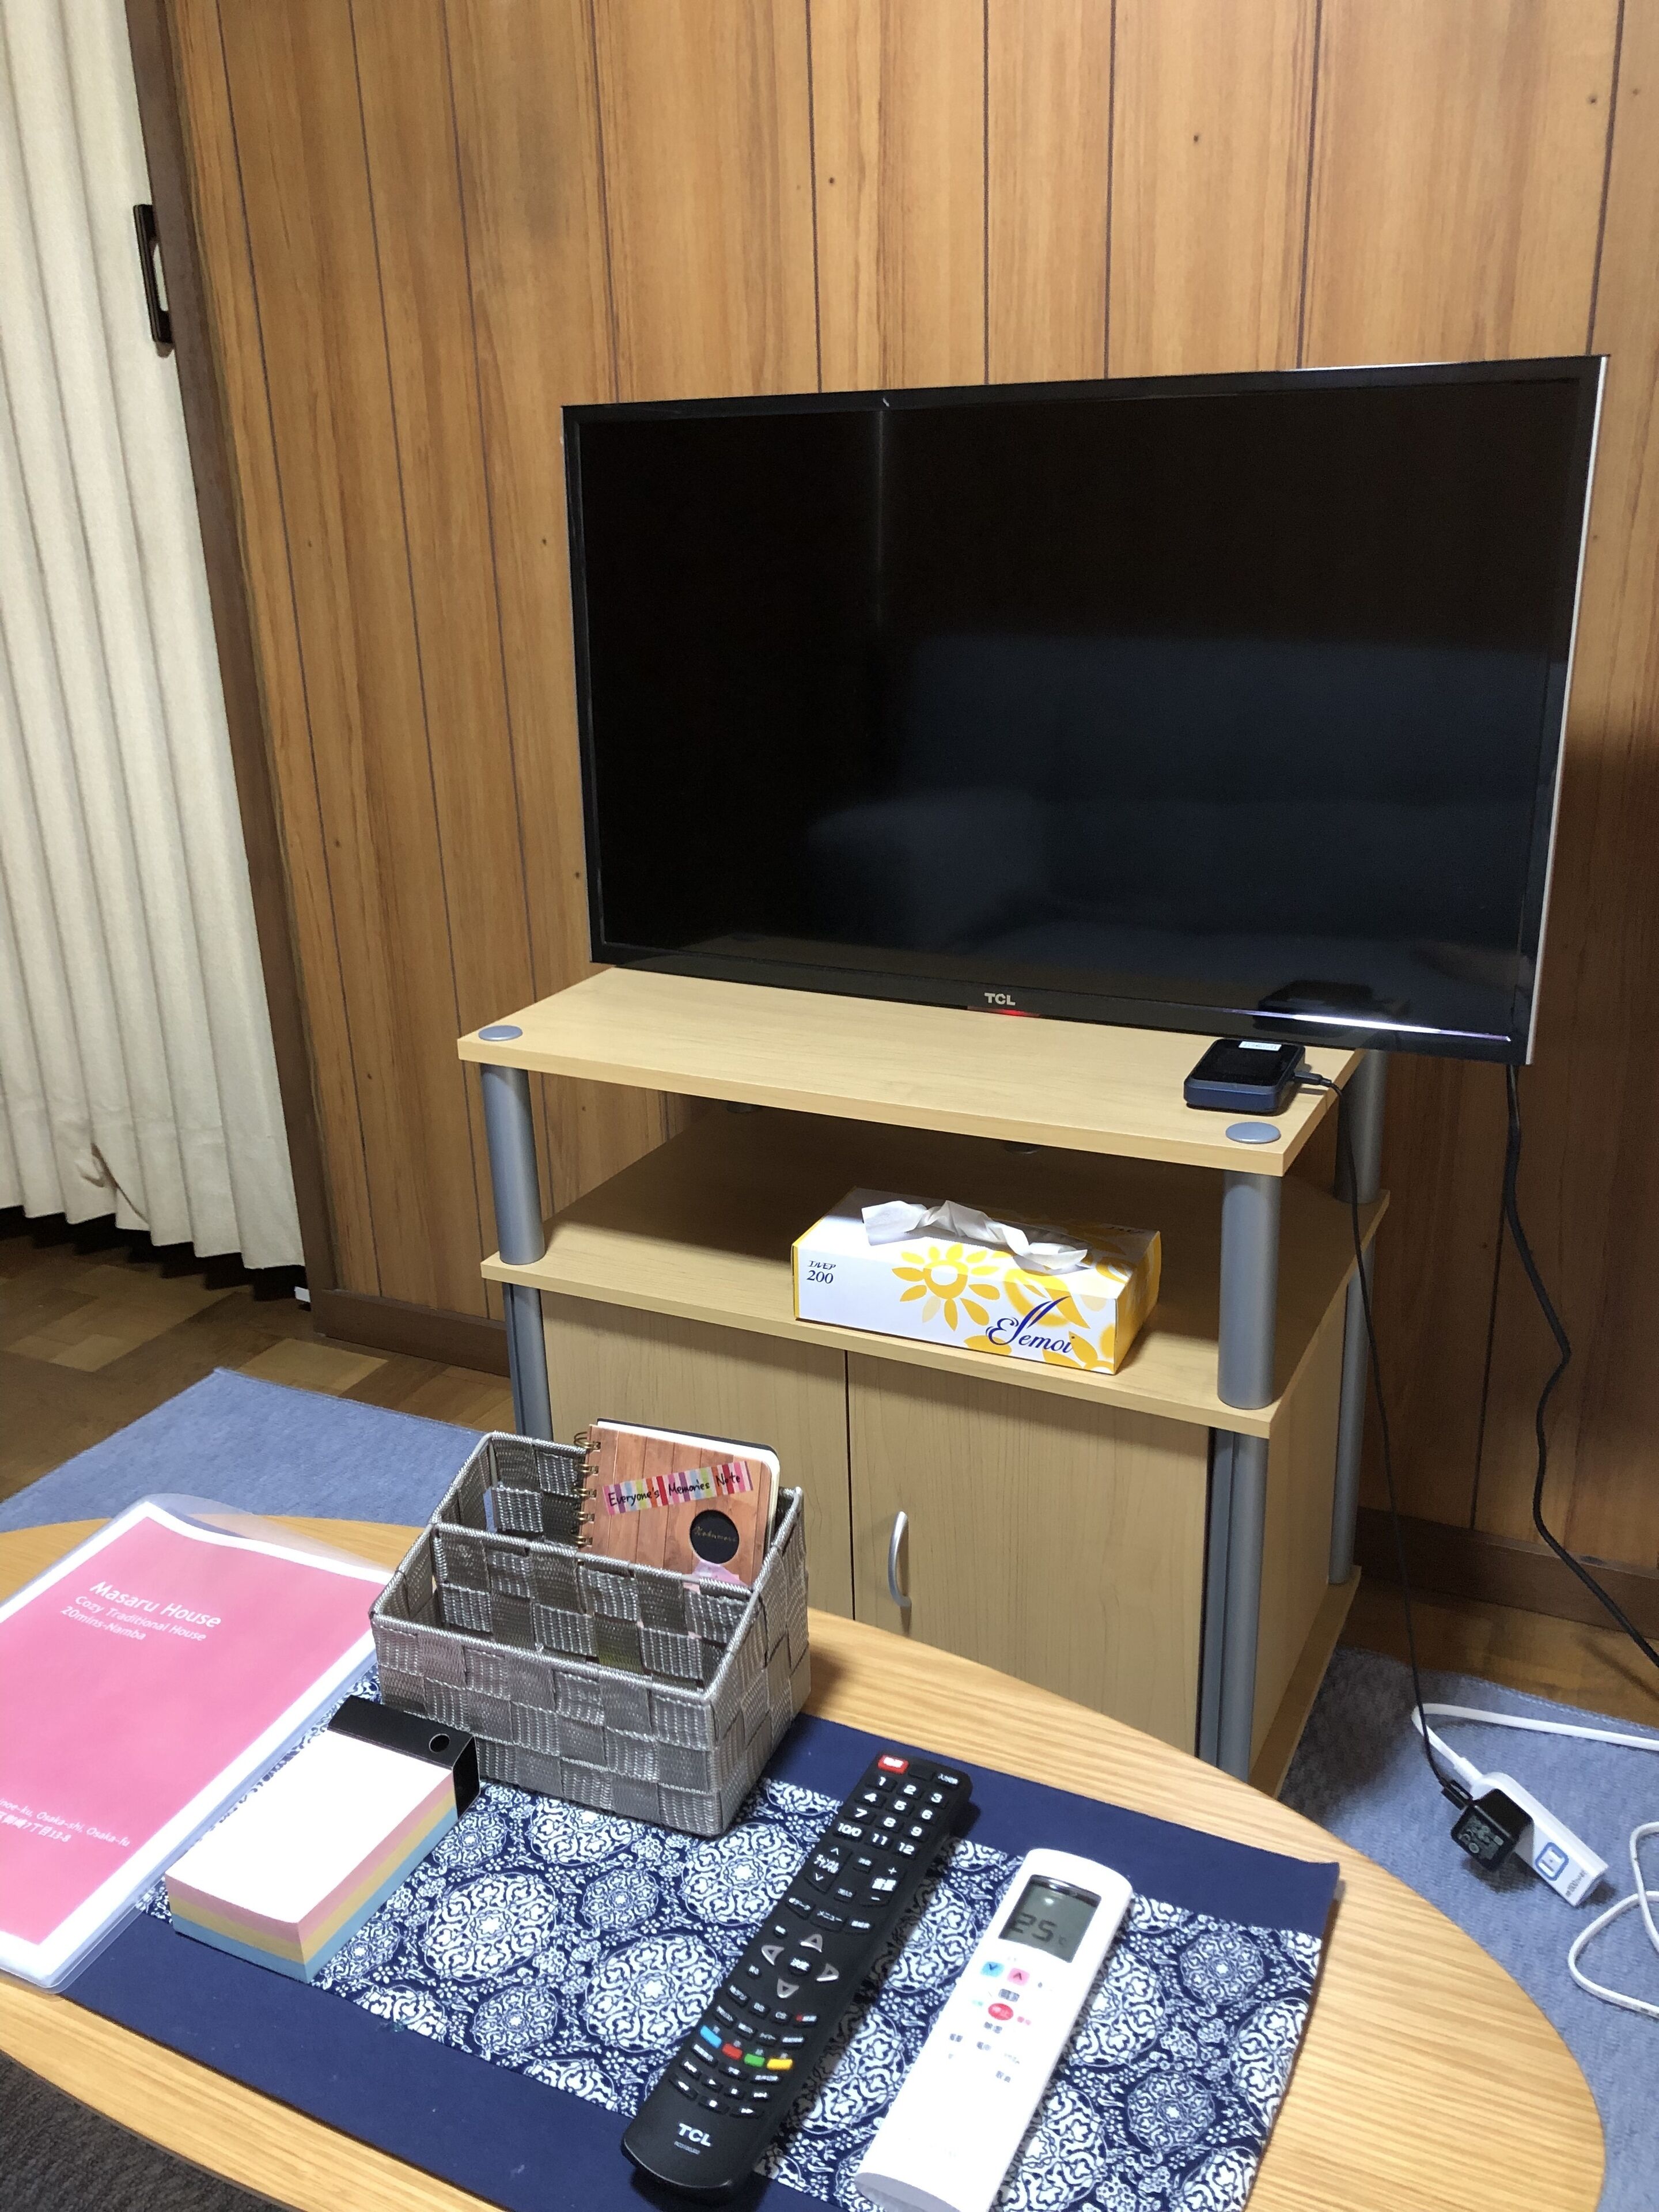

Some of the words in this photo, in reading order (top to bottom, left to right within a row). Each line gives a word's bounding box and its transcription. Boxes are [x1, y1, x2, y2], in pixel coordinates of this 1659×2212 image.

[984, 993, 1016, 1006] TCL
[806, 1270, 834, 1284] 200
[608, 1487, 660, 1506] Everyone's
[668, 1479, 710, 1495] Memories
[716, 1472, 740, 1486] Note
[89, 1581, 160, 1613] Masaru
[160, 1603, 222, 1628] House
[60, 1605, 146, 1641] 20mins-Namba
[75, 1596, 104, 1613] Cozy
[105, 1607, 171, 1632] Traditional
[169, 1624, 207, 1641] House
[878, 1777, 886, 1786] 1
[903, 1784, 916, 1795] 2
[931, 1793, 942, 1803] 3
[864, 1793, 877, 1802] 4
[894, 1800, 907, 1810] 5
[922, 1809, 933, 1820] 6
[855, 1808, 868, 1817] 7
[883, 1817, 896, 1827] 8
[911, 1826, 922, 1836] 9
[872, 1833, 888, 1845] 11
[899, 1842, 915, 1855] 12
[1010, 1912, 1058, 1942] 25
[679, 2123, 711, 2147] TCL
